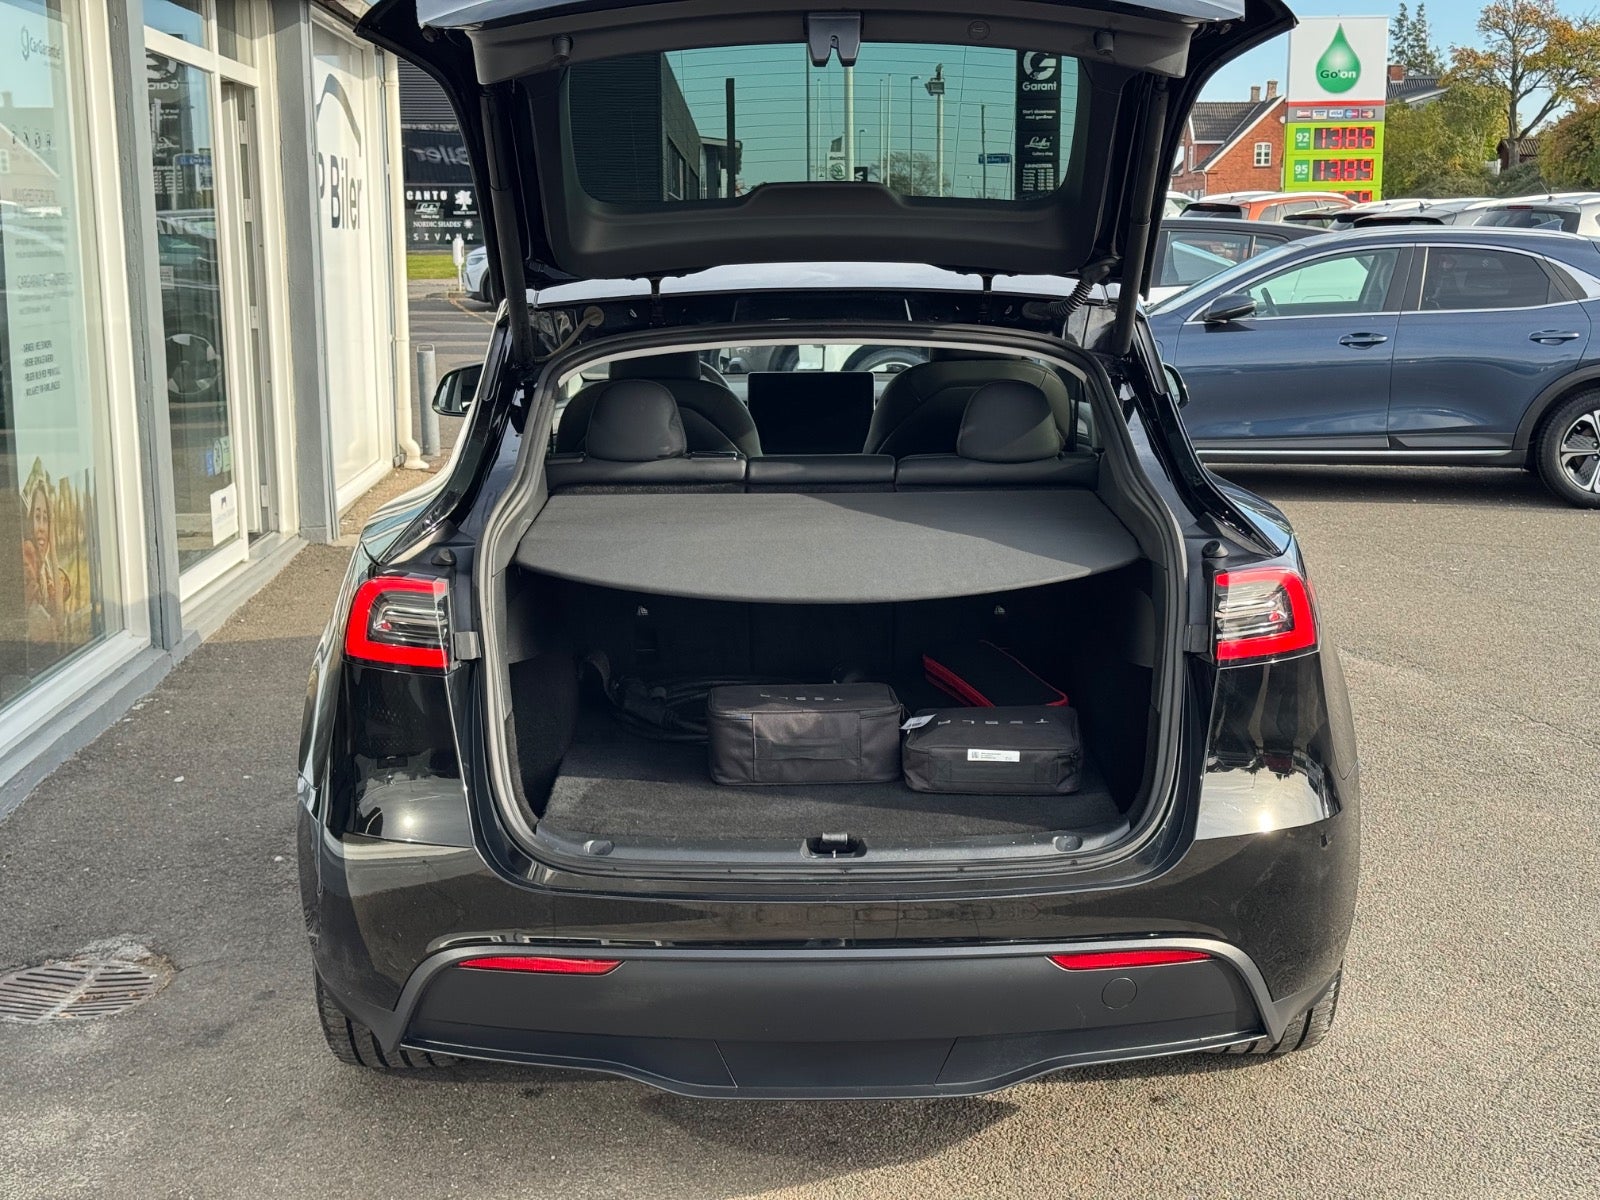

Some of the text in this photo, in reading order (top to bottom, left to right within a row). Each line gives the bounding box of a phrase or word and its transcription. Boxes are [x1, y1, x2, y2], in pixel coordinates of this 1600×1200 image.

[1320, 69, 1357, 79] Go'on
[1022, 81, 1057, 91] Garant
[1296, 132, 1309, 142] 92
[1294, 164, 1308, 174] 95
[330, 154, 362, 230] Biler
[406, 190, 448, 201] CANTO
